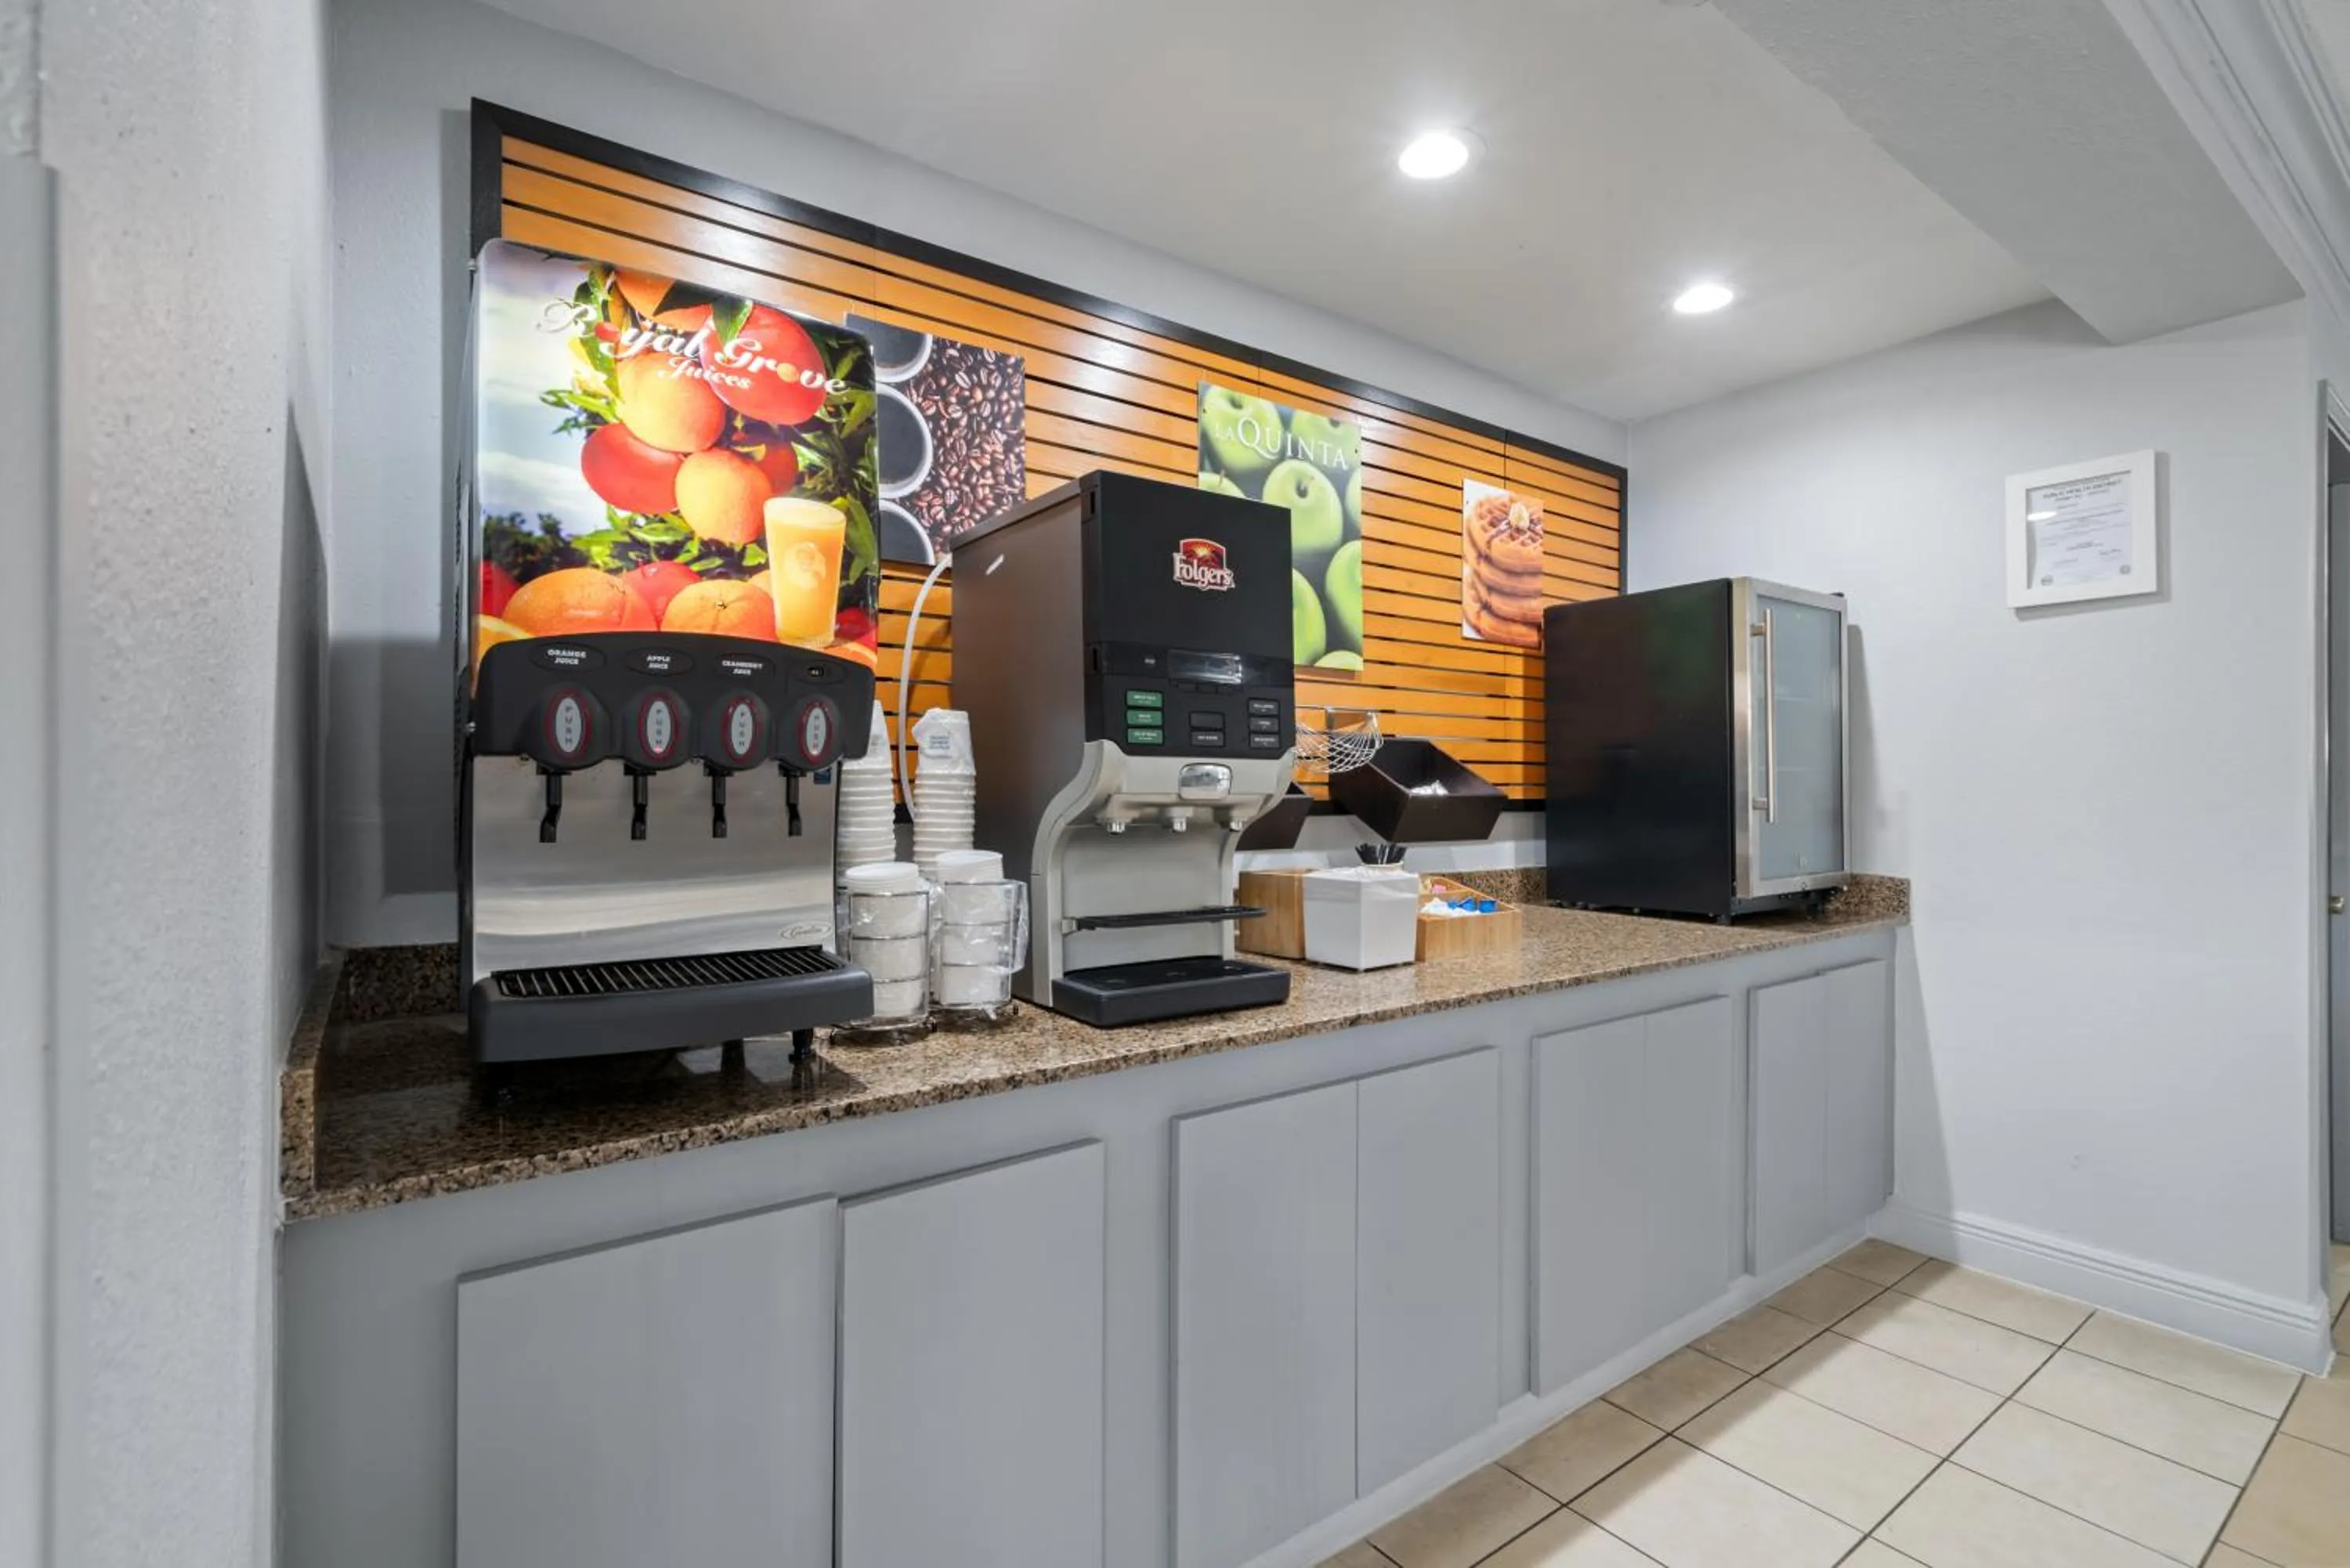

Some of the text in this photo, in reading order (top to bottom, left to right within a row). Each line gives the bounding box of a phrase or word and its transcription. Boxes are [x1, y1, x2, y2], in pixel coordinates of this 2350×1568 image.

[659, 356, 753, 389] Juices
[714, 337, 848, 395] Grove
[1238, 417, 1349, 471] QUINTA
[1173, 553, 1233, 589] Folgers
[548, 649, 587, 659] ORANGE
